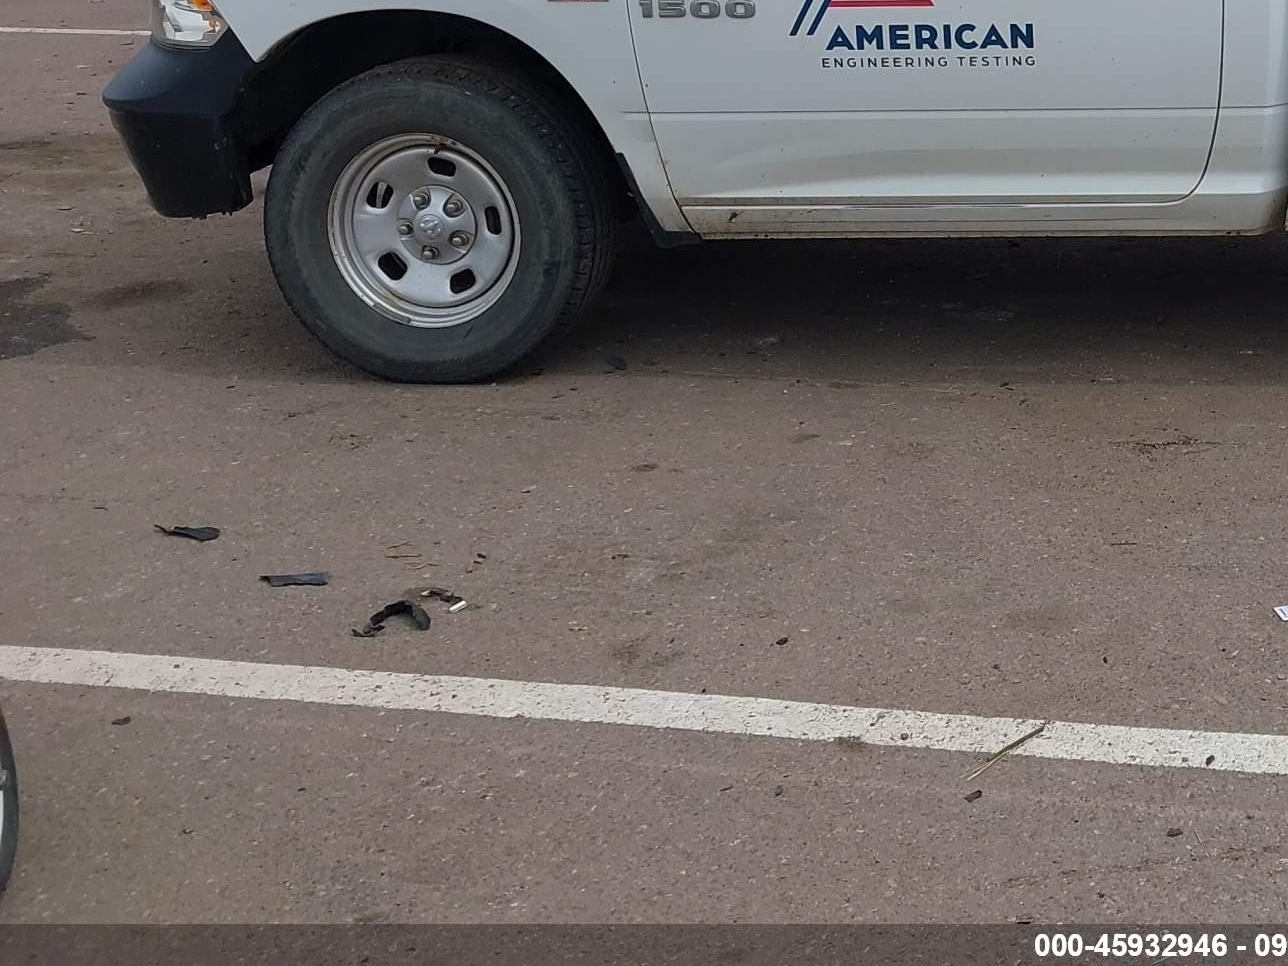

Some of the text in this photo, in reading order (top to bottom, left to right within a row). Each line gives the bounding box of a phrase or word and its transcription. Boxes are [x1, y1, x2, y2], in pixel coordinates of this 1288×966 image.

[639, 0, 756, 19] 1500
[825, 23, 1034, 50] AMERICAN
[821, 55, 1036, 68] ENGINEERING TESTING
